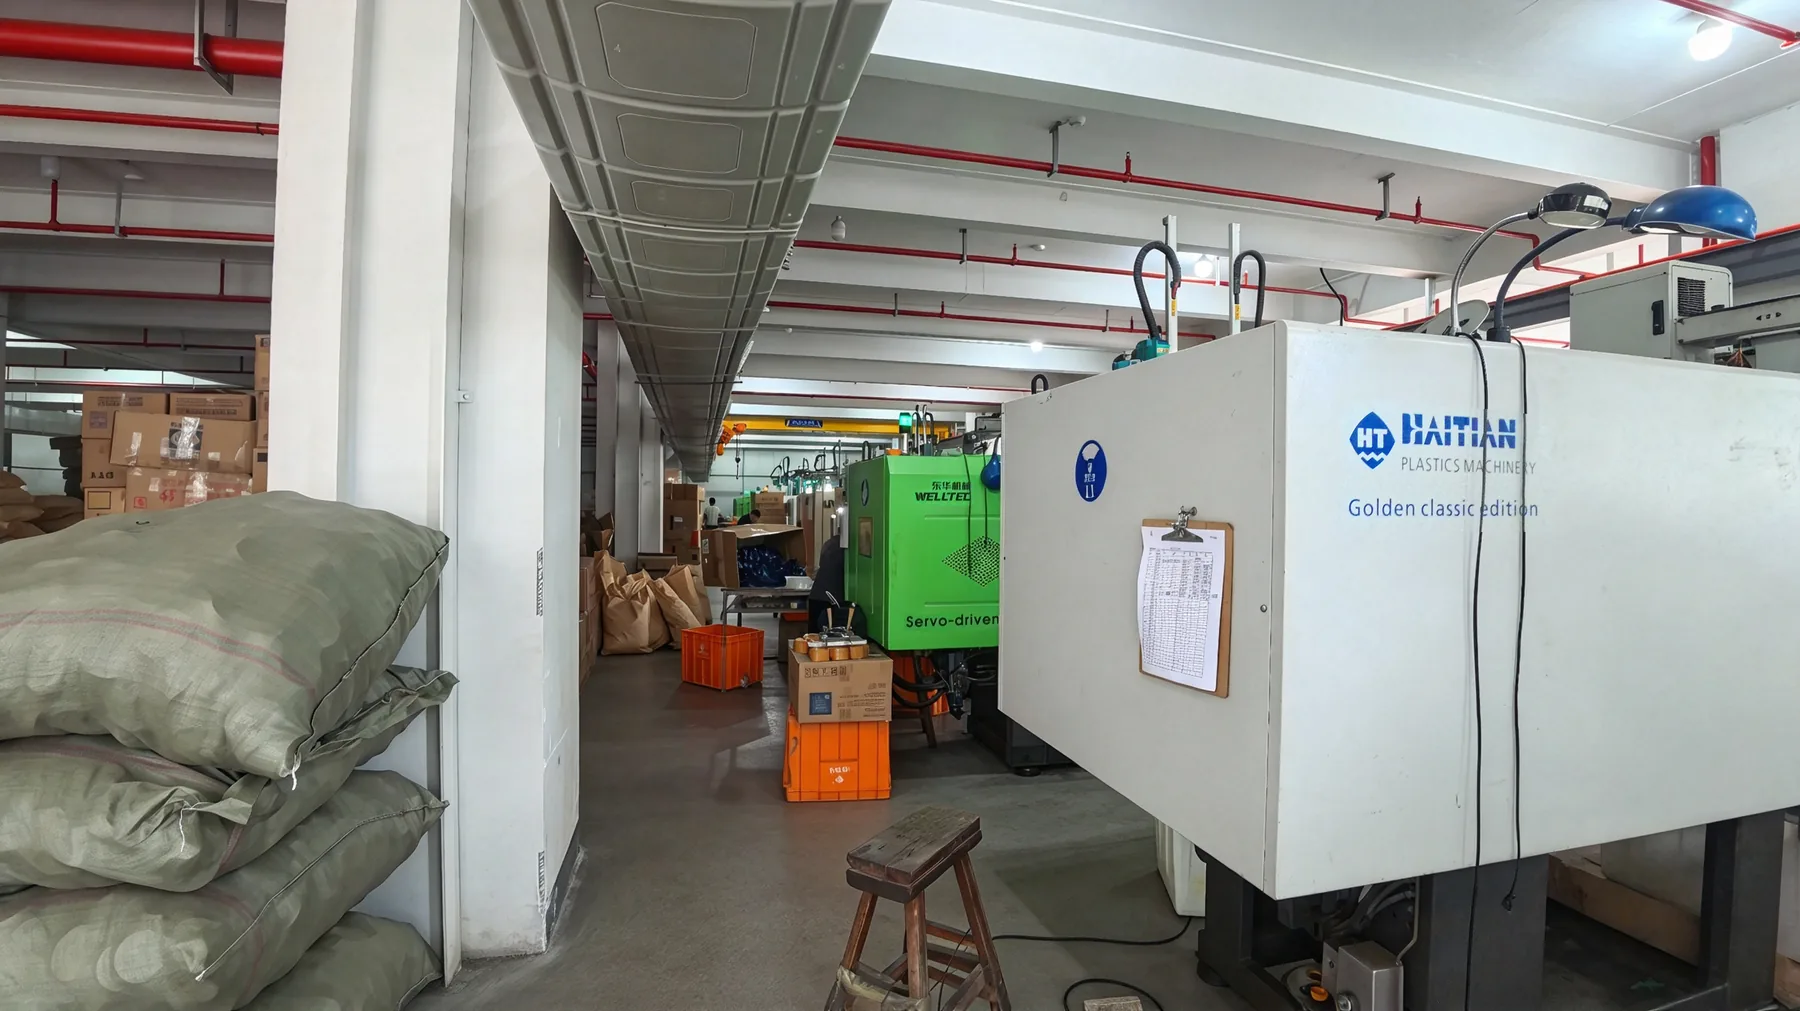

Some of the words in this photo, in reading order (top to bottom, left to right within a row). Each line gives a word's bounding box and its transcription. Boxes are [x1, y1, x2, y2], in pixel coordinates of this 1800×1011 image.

[1357, 427, 1388, 449] HT
[1402, 413, 1516, 449] HAITIAN
[1401, 456, 1460, 473] PLASTICS
[1348, 498, 1416, 517] Golden
[1421, 498, 1475, 517] classic
[1480, 499, 1538, 517] edition
[906, 613, 999, 628] Servo-driven
